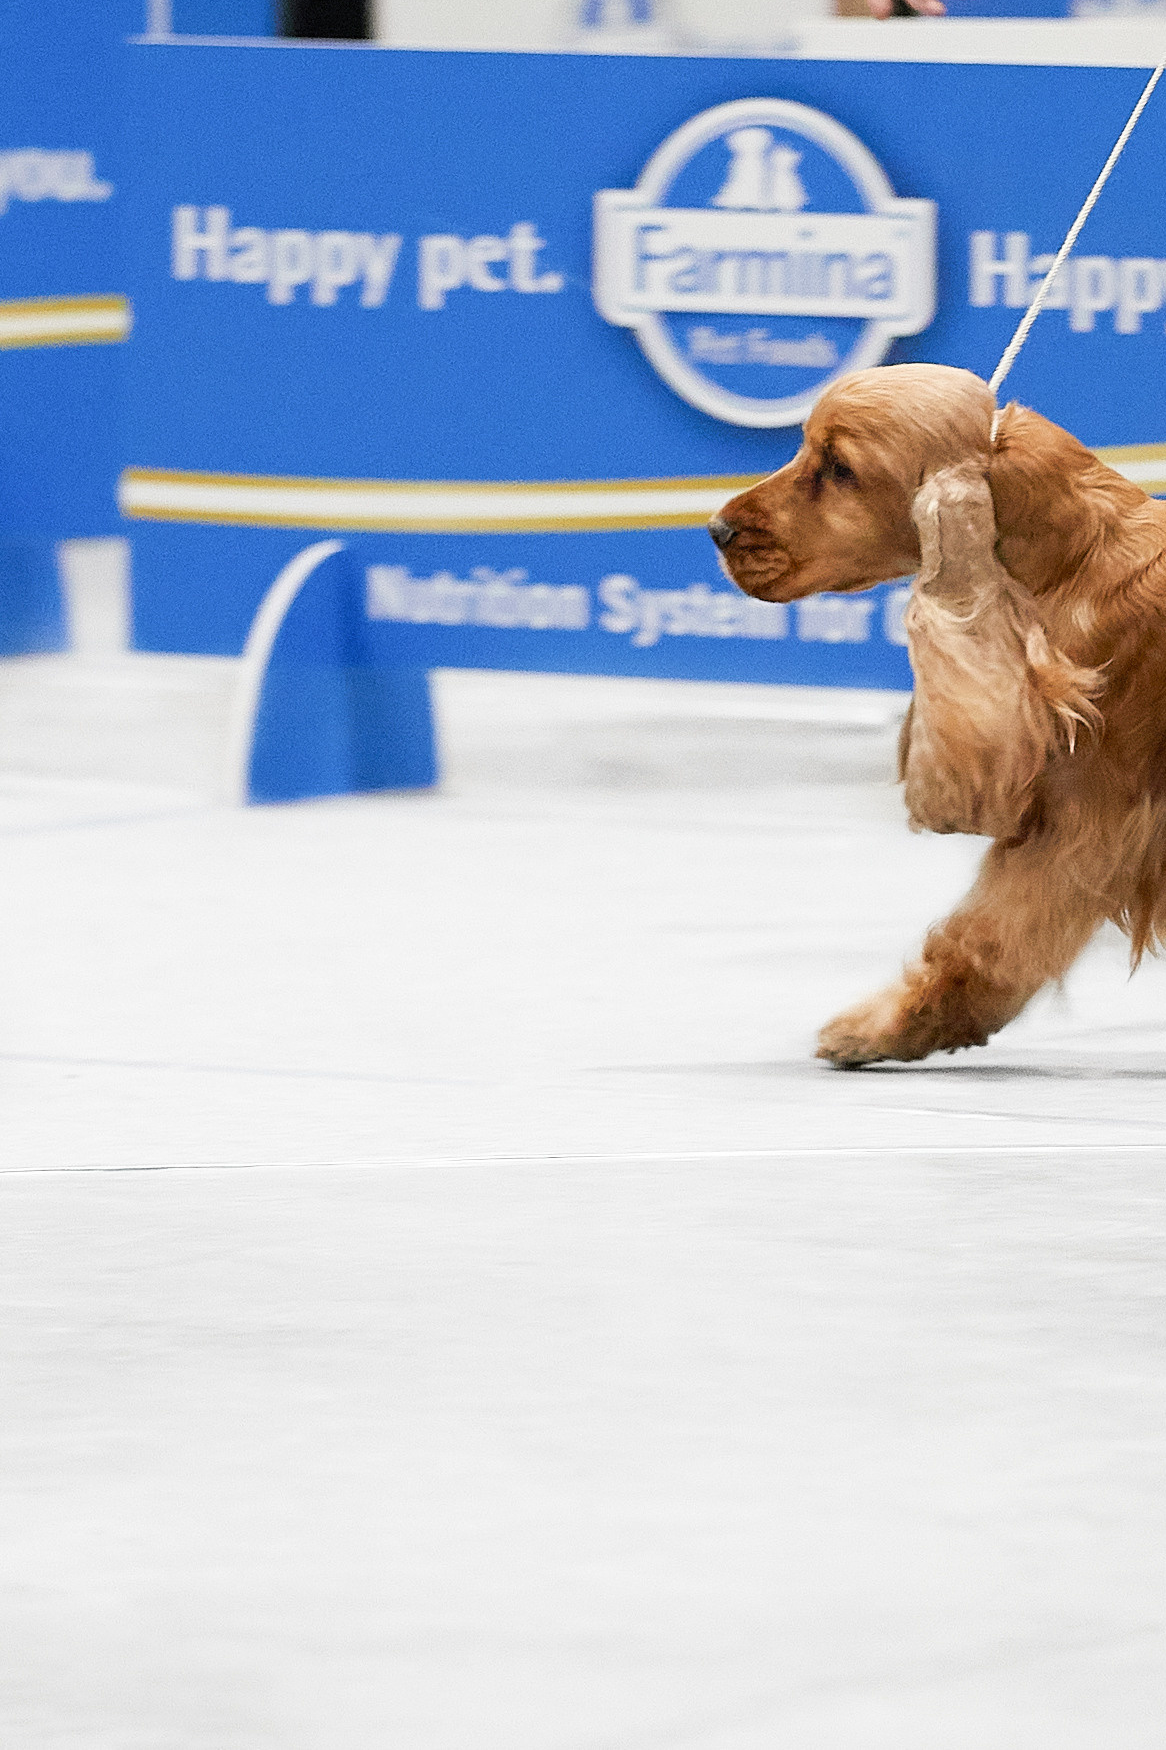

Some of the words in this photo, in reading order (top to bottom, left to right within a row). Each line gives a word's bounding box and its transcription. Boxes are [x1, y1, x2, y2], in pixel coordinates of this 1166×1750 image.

[171, 203, 402, 308] Happy
[417, 222, 565, 311] pet.
[634, 222, 896, 302] Farmina
